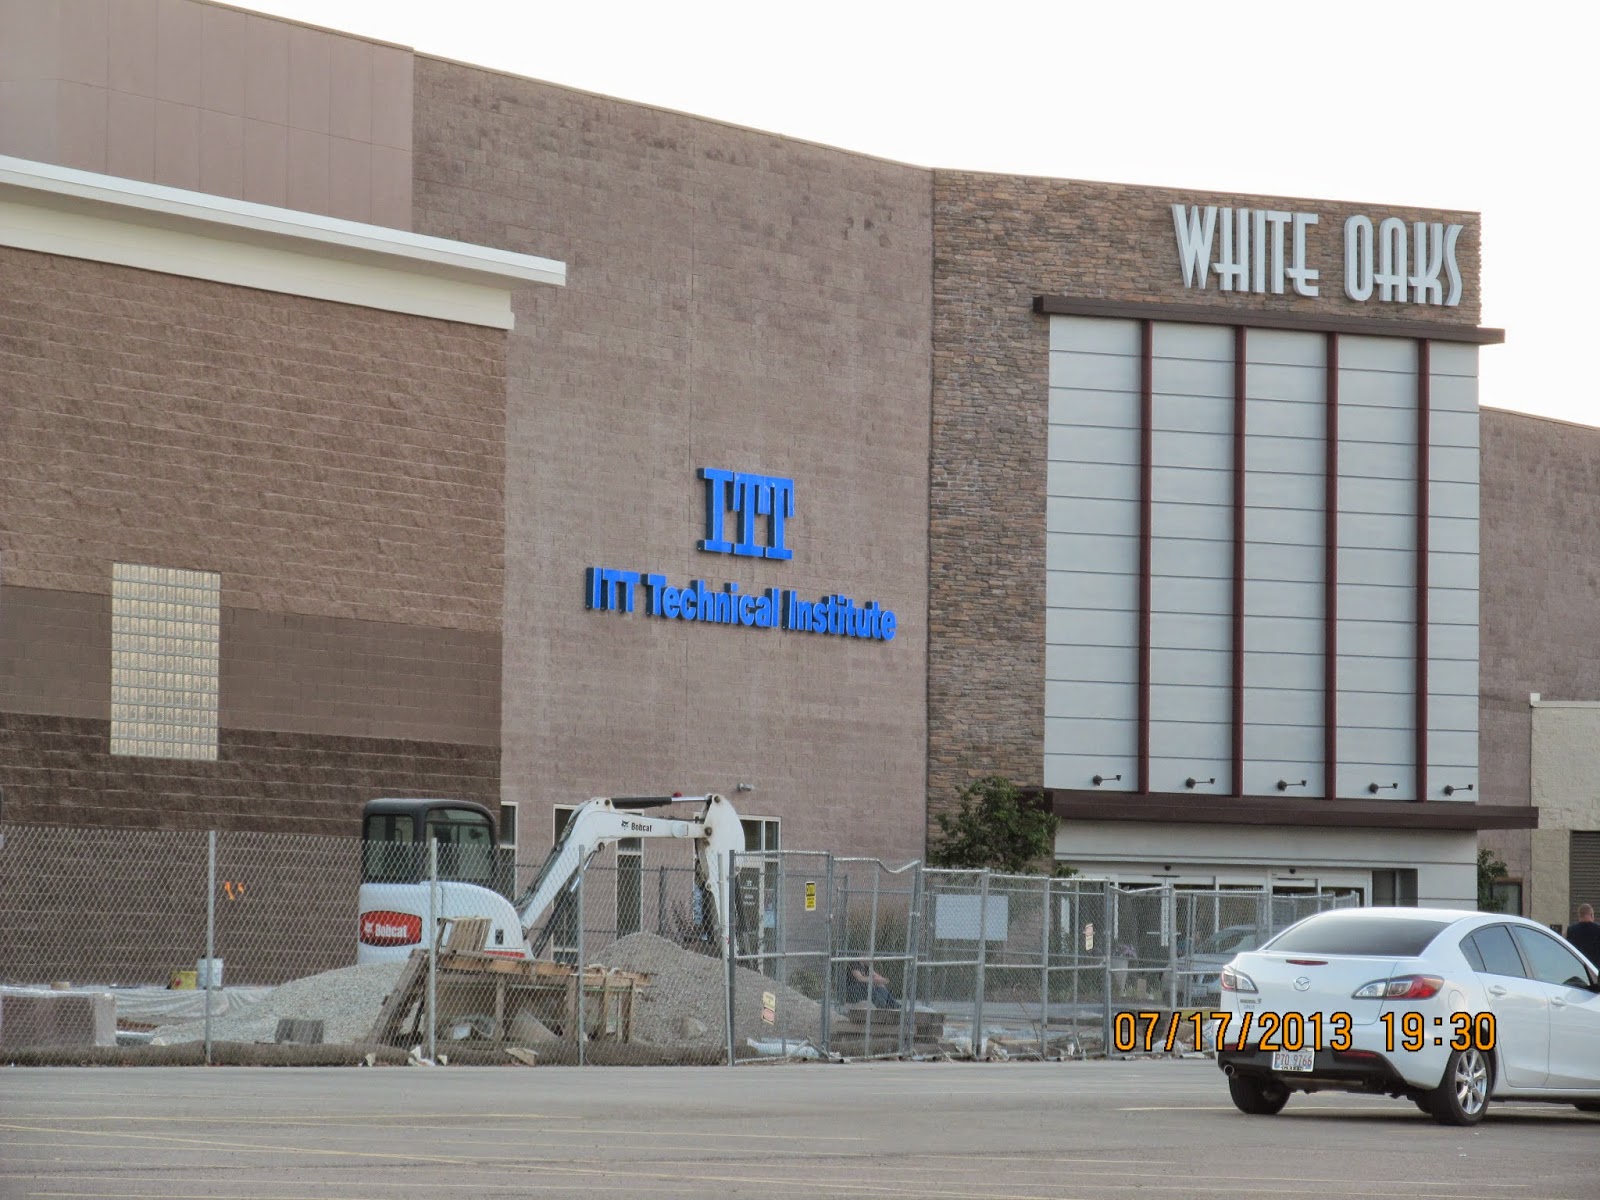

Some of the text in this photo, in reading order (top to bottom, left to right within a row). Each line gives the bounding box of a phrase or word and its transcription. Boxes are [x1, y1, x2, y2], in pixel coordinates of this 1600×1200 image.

[1171, 203, 1464, 307] WHITE OAKS
[697, 467, 795, 560] ITT
[586, 566, 897, 642] ITT Technical Institute
[631, 822, 652, 832] Bobcat
[375, 923, 408, 938] Bobcat
